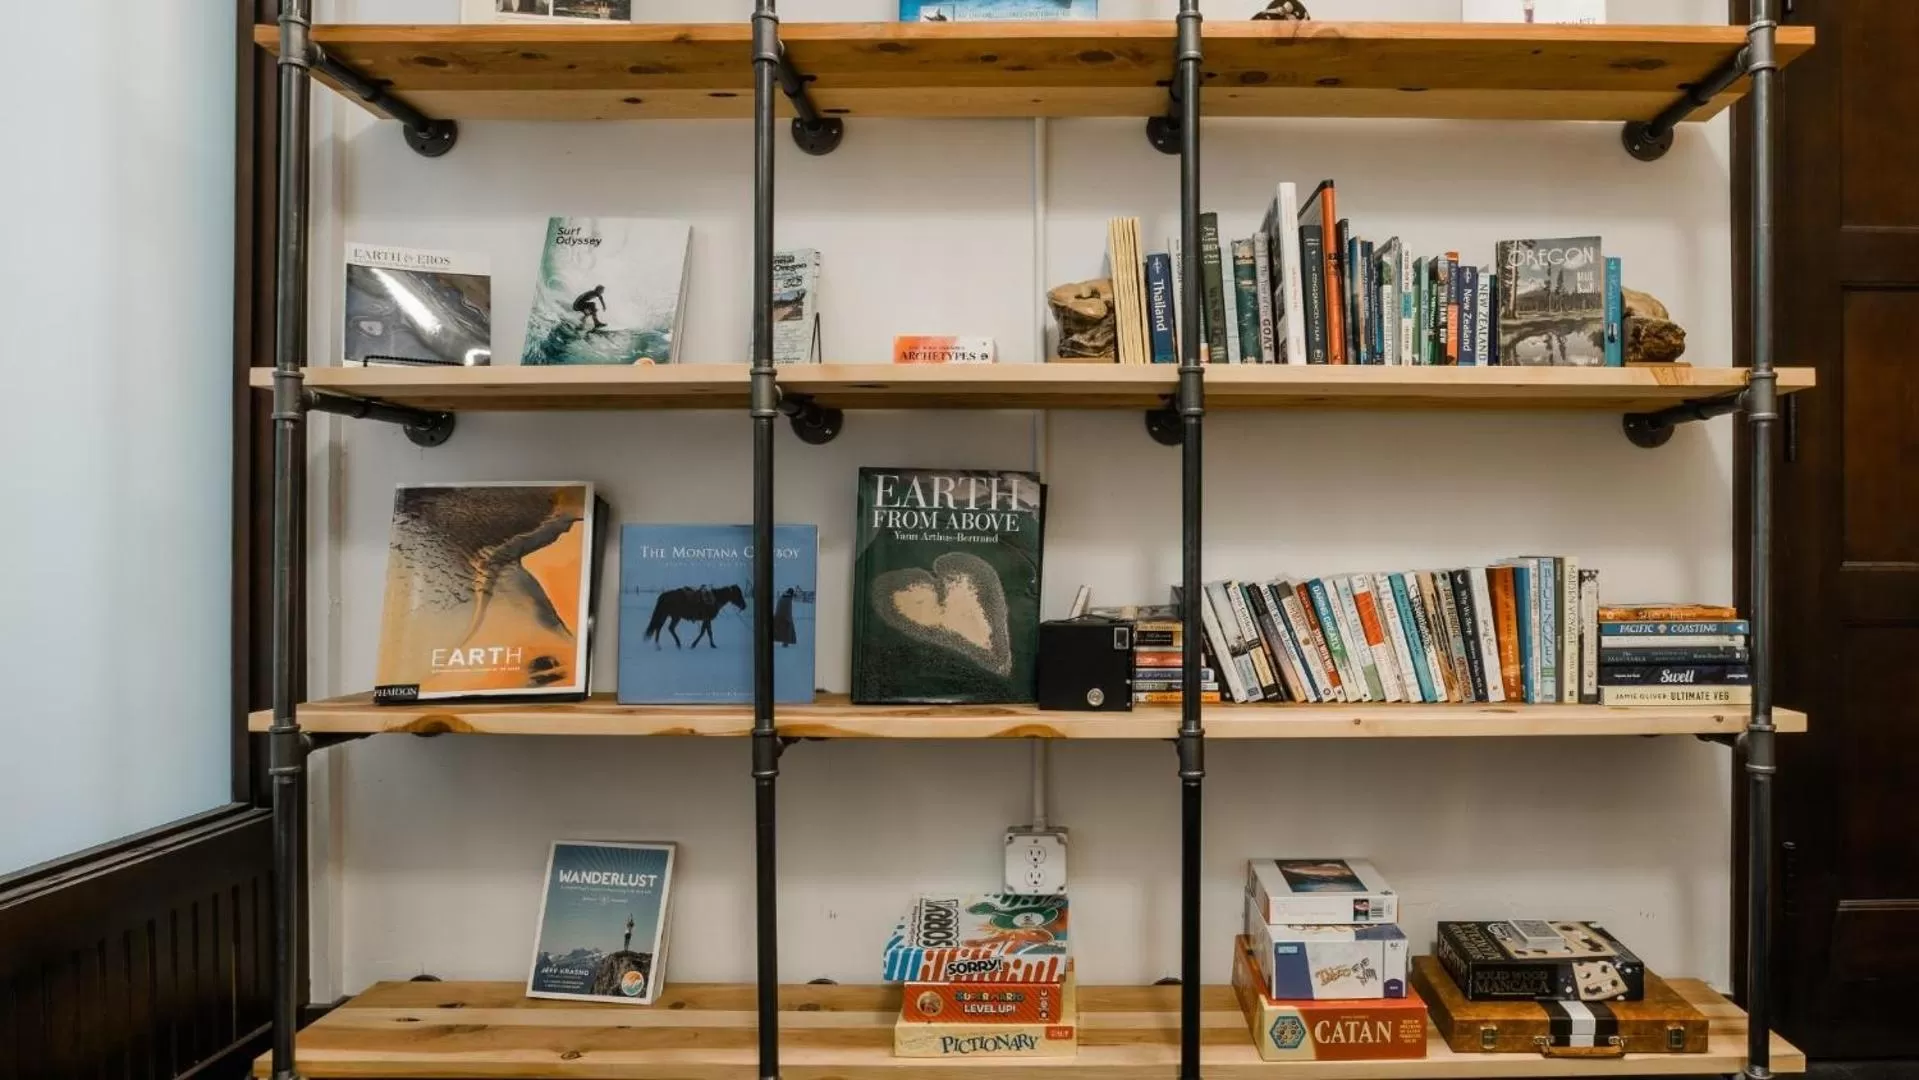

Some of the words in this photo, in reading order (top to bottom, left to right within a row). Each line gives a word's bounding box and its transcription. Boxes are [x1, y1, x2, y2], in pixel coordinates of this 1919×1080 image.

[557, 227, 581, 236] Surf
[556, 236, 602, 247] Odyssey
[354, 248, 402, 263] EARTH
[416, 254, 451, 266] EROS
[1508, 247, 1594, 266] OREGON
[1153, 279, 1168, 331] Thailand
[1463, 288, 1472, 310] New
[1479, 284, 1488, 307] NEW
[1262, 319, 1274, 351] GOAT
[1463, 312, 1472, 352] Zealand
[1478, 311, 1488, 361] ZEALAND
[901, 351, 976, 360] ARCHETYPES
[872, 474, 1024, 511] EARTH
[872, 510, 937, 529] FROM
[946, 512, 1020, 532] ABOVE
[895, 531, 918, 541] Yann
[920, 531, 999, 543] Arthus-Bertrand
[640, 546, 665, 559] THE
[671, 546, 738, 559] MONTANA
[744, 546, 800, 560] CBOY
[1311, 585, 1329, 616] DARING
[1324, 617, 1342, 652] GREATLY
[1568, 606, 1576, 645] VOYAGE
[1619, 624, 1653, 633] PACIFIC
[1671, 624, 1717, 633] COASTING
[431, 647, 522, 667] EARTH
[1660, 669, 1695, 683] Swell
[1670, 692, 1710, 701] ULTIMATE
[1713, 692, 1729, 701] VEG
[559, 869, 657, 887] WANDERLUST
[947, 958, 1002, 976] SORRY!
[1475, 980, 1551, 993] MANCALA
[964, 1004, 997, 1013] LEVEL
[999, 1004, 1016, 1013] UP!
[1314, 1020, 1392, 1044] CATAN
[940, 1033, 1039, 1054] PICTIONARY
